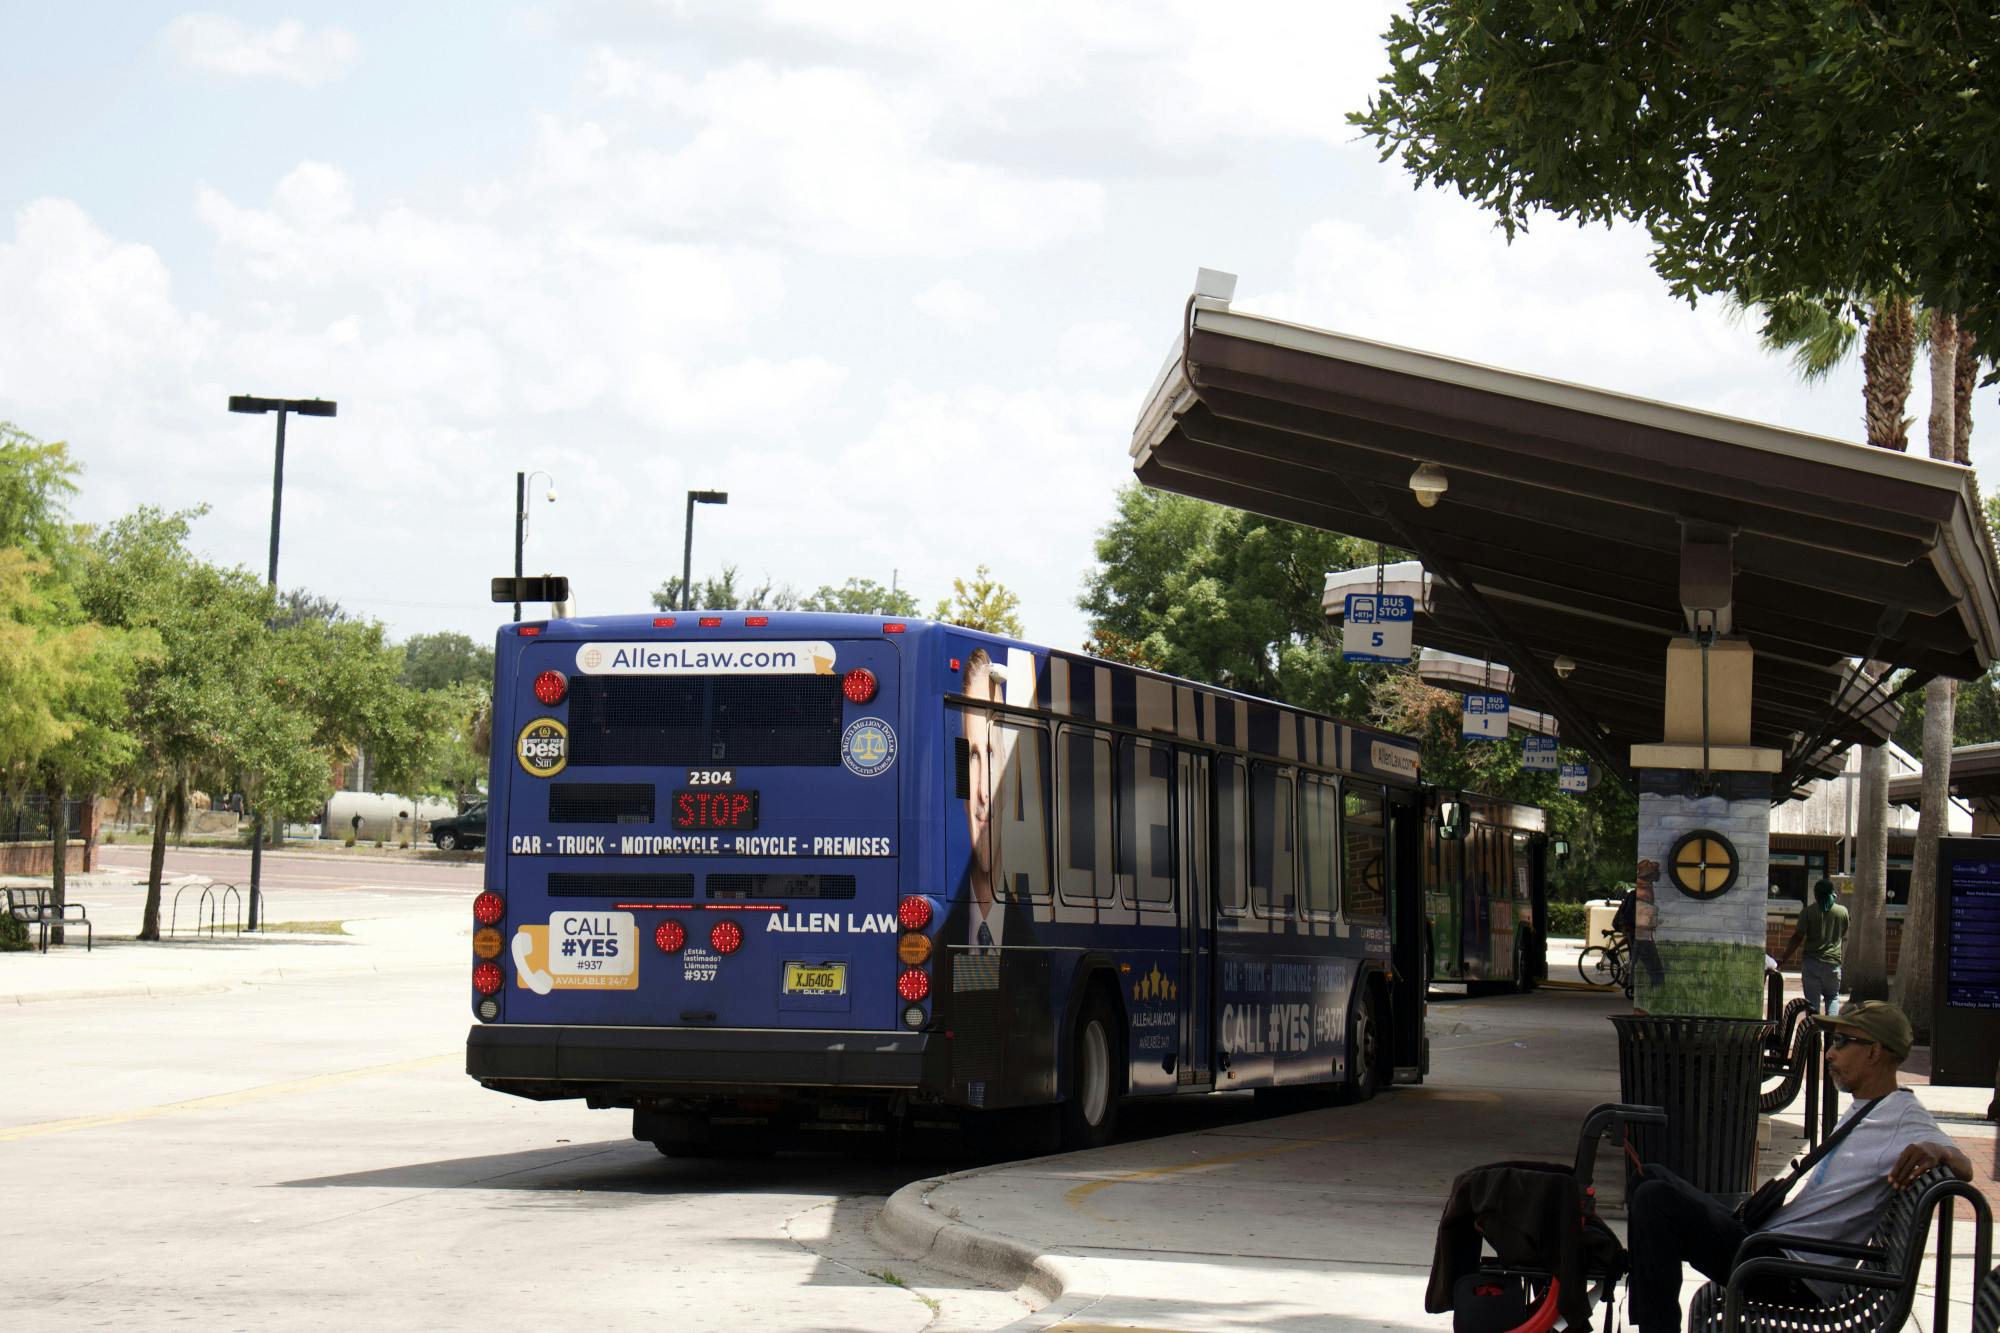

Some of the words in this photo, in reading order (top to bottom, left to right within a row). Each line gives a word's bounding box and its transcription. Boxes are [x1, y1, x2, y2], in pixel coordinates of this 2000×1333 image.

[1383, 598, 1405, 607] BUS
[1379, 608, 1408, 616] STOP
[1371, 632, 1384, 647] 5
[612, 648, 797, 669] AllenLaw.com
[1482, 719, 1489, 729] 1
[535, 757, 552, 768] Sun
[1378, 747, 1413, 771] AllenLaw.com
[689, 771, 732, 785] 2304
[1001, 646, 1216, 930] ALLEN
[677, 793, 750, 827] STOP
[512, 836, 541, 854] CAR
[557, 836, 605, 854] TRUCK
[621, 836, 720, 855] MOTORCYCLE
[736, 837, 797, 855] BICYCLE
[814, 837, 890, 856] PREMISES
[563, 917, 618, 936] CALL
[766, 912, 840, 932] ALLEN
[847, 913, 898, 933] LAW
[562, 938, 619, 957] #YES
[684, 947, 706, 956] ¿Estás
[577, 960, 603, 970] #937
[684, 962, 718, 970] Llámanos
[555, 977, 606, 985] AVAILABLE
[607, 977, 629, 986] 24/7
[684, 970, 717, 981] #937
[1223, 960, 1238, 992] CAR
[1222, 1003, 1265, 1054] CALL
[1269, 1003, 1310, 1052] #YES
[1313, 1003, 1346, 1048] (#937)
